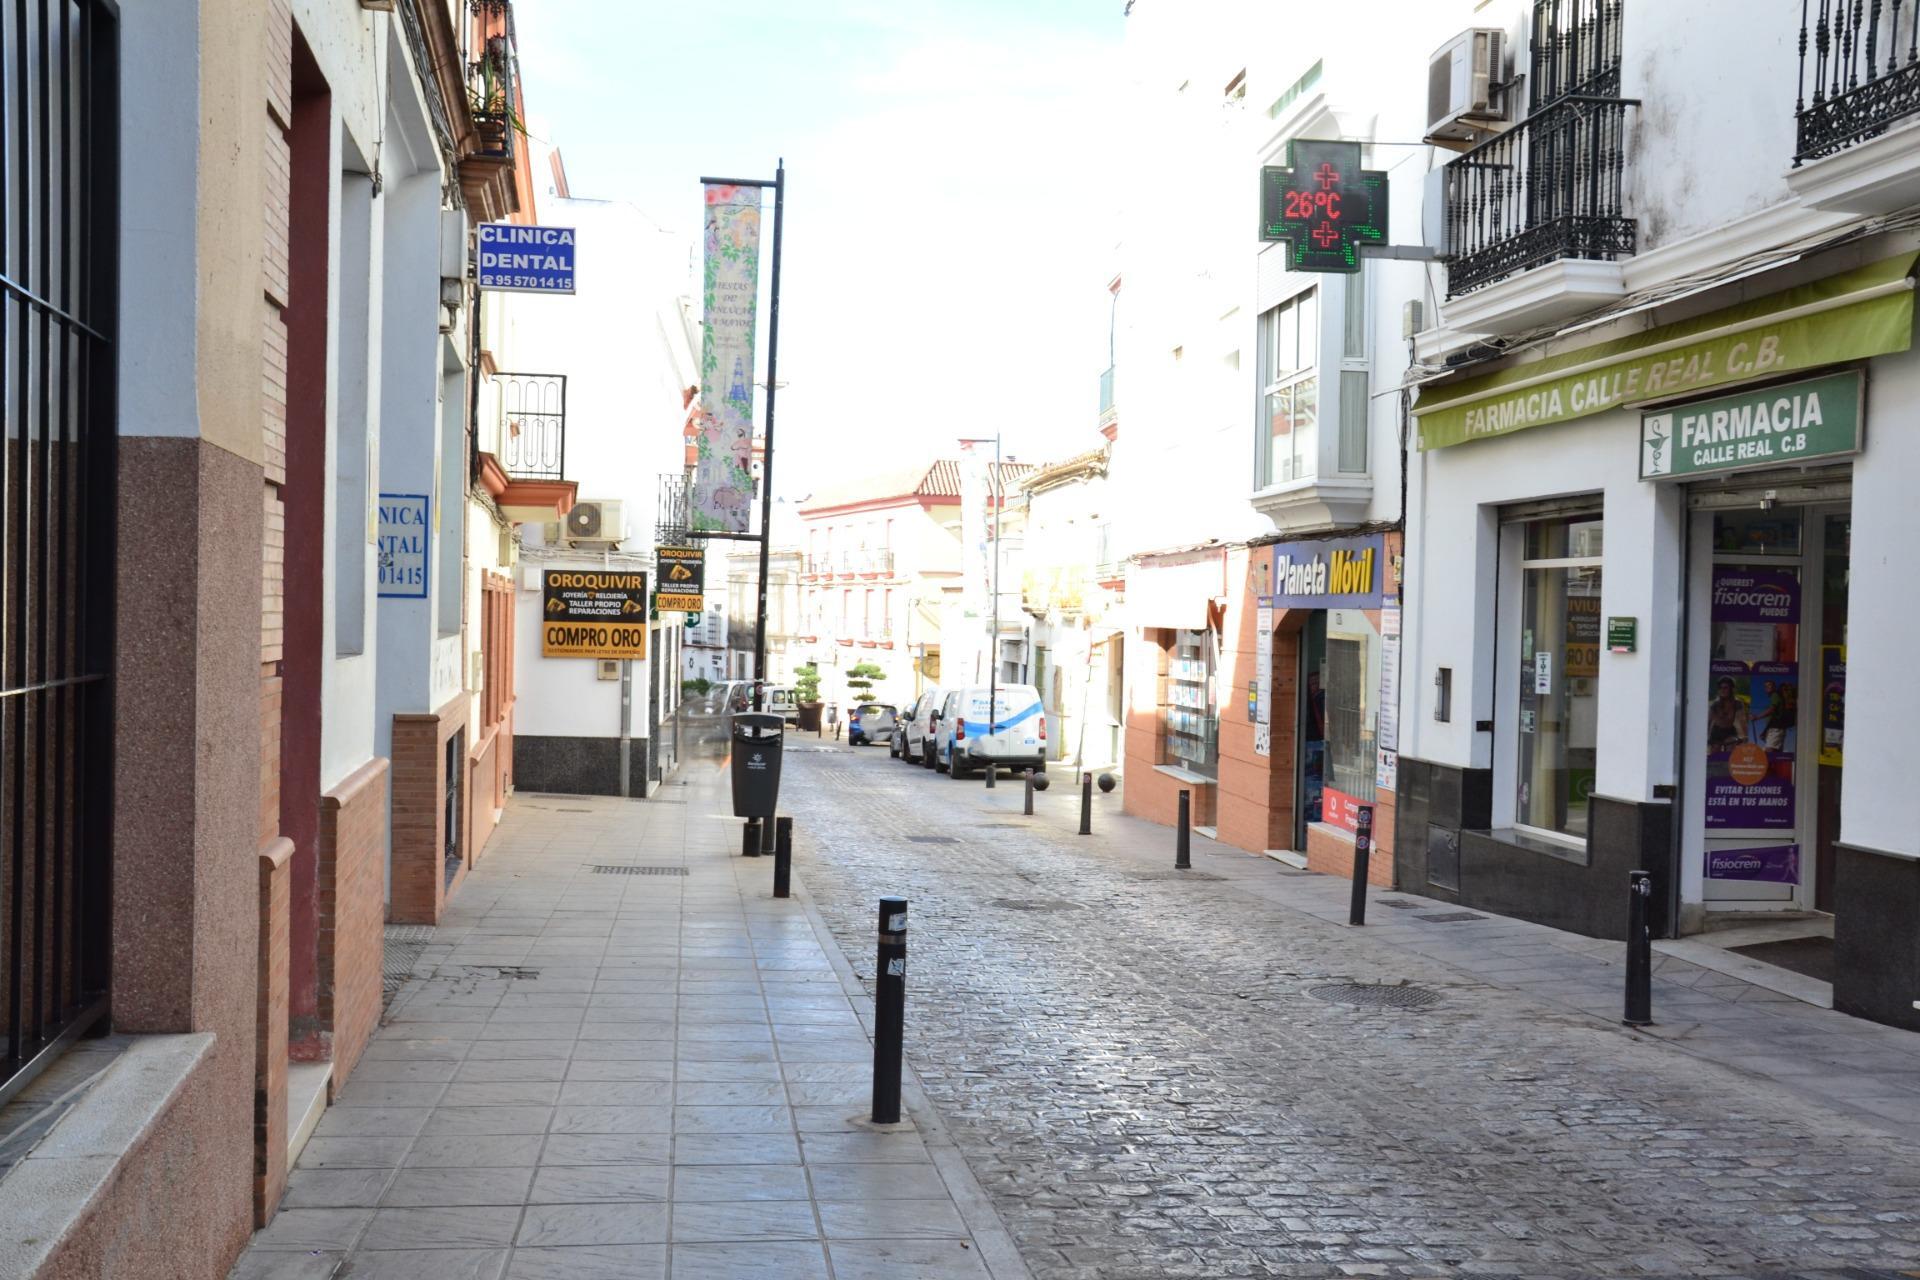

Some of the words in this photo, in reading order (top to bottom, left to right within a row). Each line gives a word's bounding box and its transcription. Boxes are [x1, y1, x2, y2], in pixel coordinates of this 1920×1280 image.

[481, 227, 574, 245] CLINICA
[482, 253, 572, 270] DENTAL
[496, 275, 511, 286] 95
[514, 276, 537, 287] 570
[540, 277, 554, 287] 14
[557, 278, 572, 289] 15
[1465, 389, 1563, 437] FARMACIA
[1571, 366, 1641, 412] CALLE
[1645, 351, 1713, 394] REAL
[1727, 335, 1785, 374] C.B.
[1681, 392, 1823, 448] FARMACIA
[1694, 445, 1734, 465] CALLE
[1738, 439, 1773, 459] REAL
[1781, 433, 1806, 453] C.B
[660, 550, 702, 558] OROQUIVIR
[1277, 554, 1326, 595] Planeta
[1328, 547, 1375, 594] Móvil
[549, 574, 641, 590] OROQUIVIR
[569, 600, 593, 608] TALLER
[658, 597, 686, 609] COMPRO
[688, 598, 701, 610] ORO
[1713, 587, 1791, 607] fisiocrem
[568, 607, 621, 616] REPARACIONES
[1760, 607, 1789, 616] PUEDES
[547, 627, 607, 647] COMPRO
[611, 628, 641, 648] ORO
[1715, 786, 1743, 795] EVITAR
[1745, 786, 1782, 795] LESIONES
[1708, 795, 1727, 806] ESTÁ
[1728, 797, 1740, 806] EN
[1742, 797, 1756, 806] TUS
[1758, 797, 1788, 807] MANOS
[1711, 858, 1761, 870] fisiocrem
